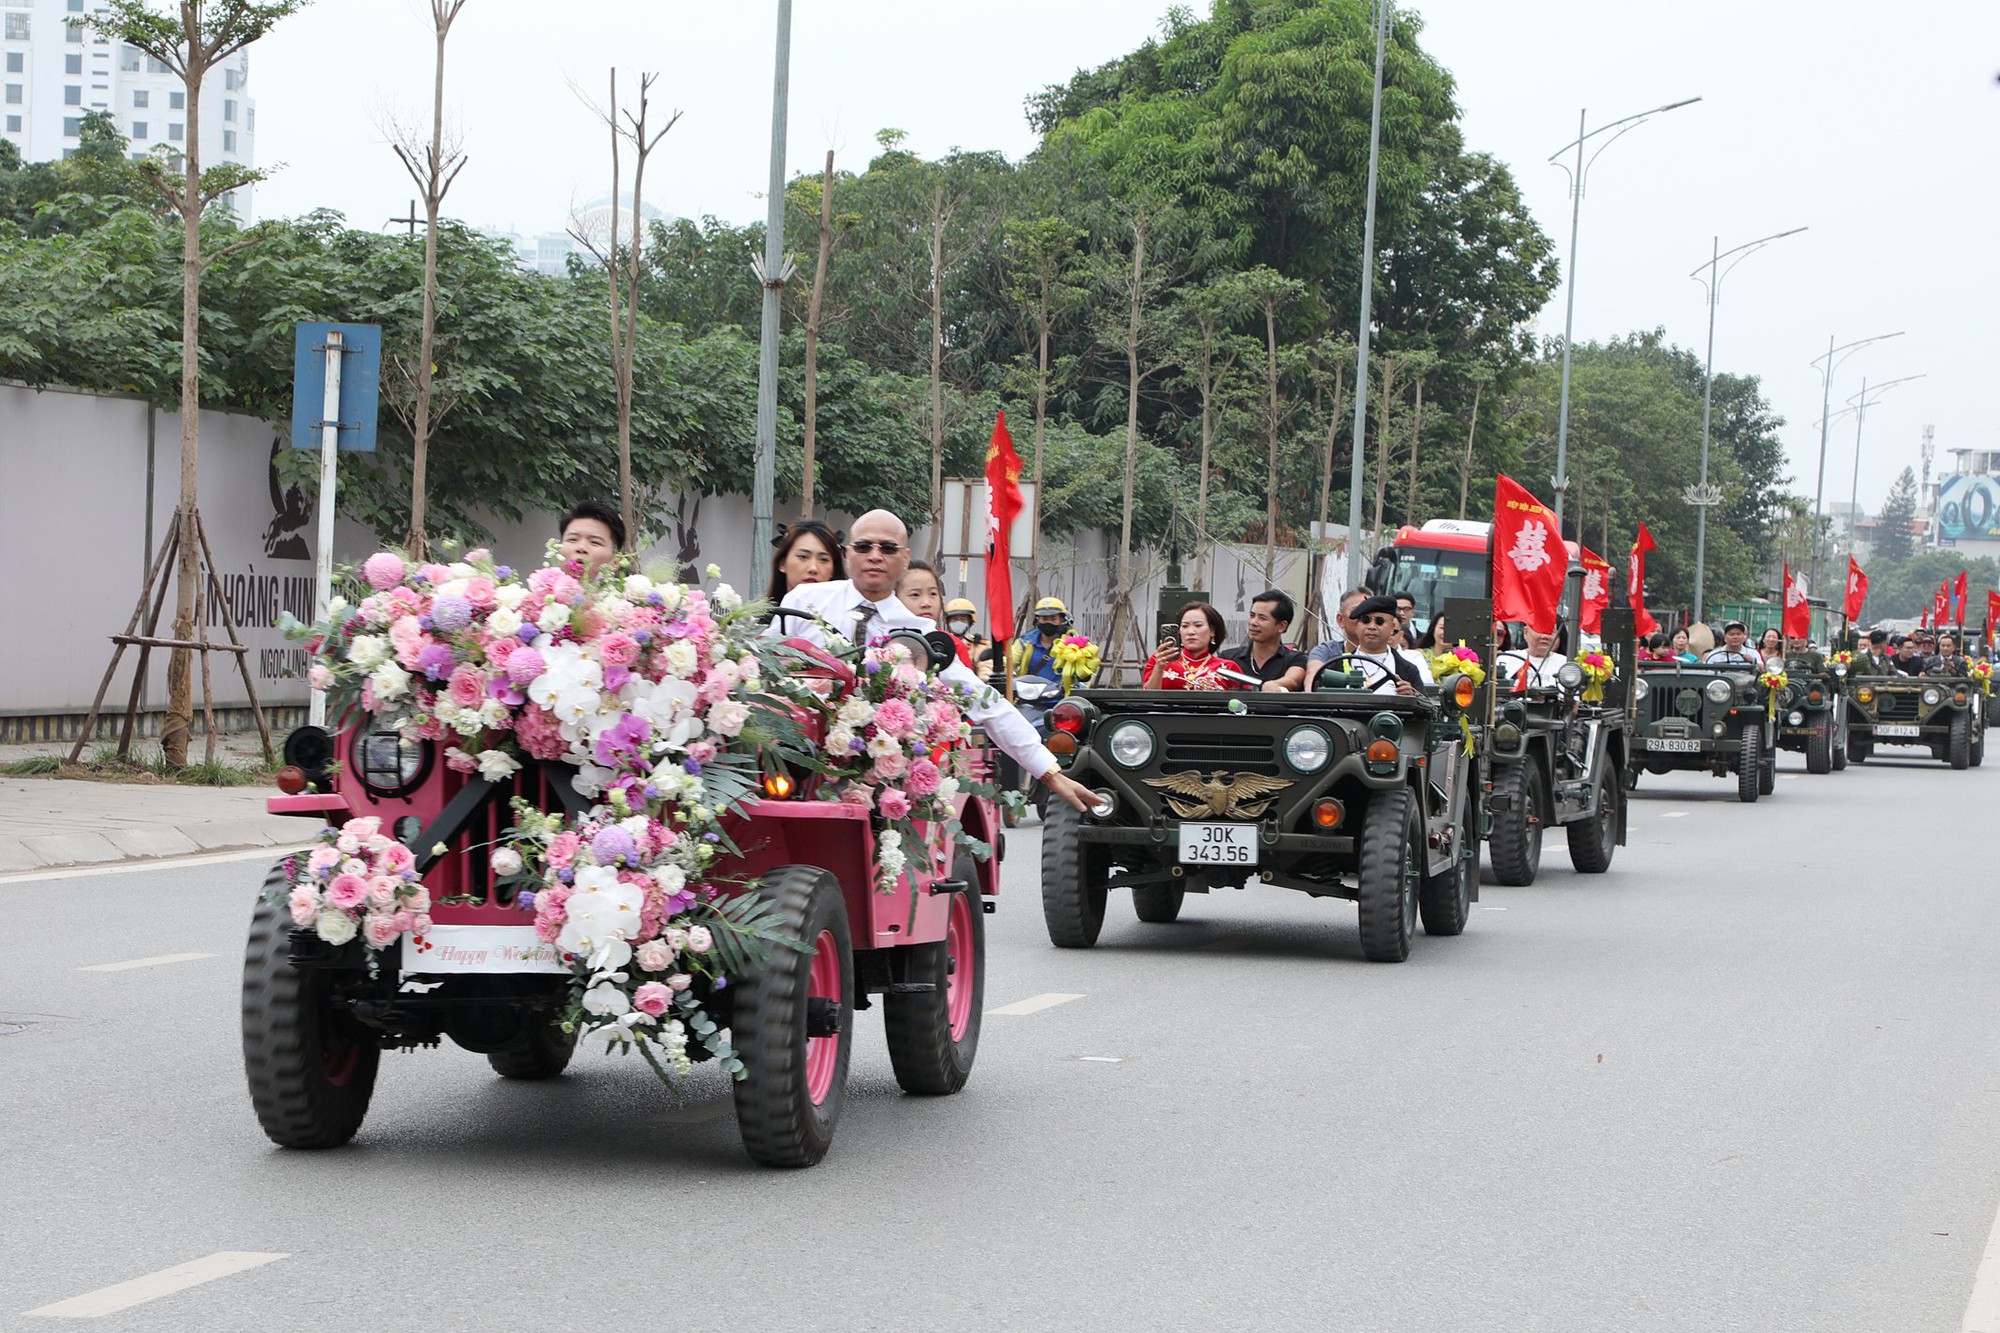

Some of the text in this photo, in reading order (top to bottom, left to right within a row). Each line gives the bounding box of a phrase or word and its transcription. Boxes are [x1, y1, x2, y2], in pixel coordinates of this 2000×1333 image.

[283, 576, 318, 628] MIN
[259, 648, 285, 686] NGỌC
[1202, 827, 1235, 843] 30K
[1188, 845, 1249, 862] 343.56
[435, 945, 488, 966] Happy
